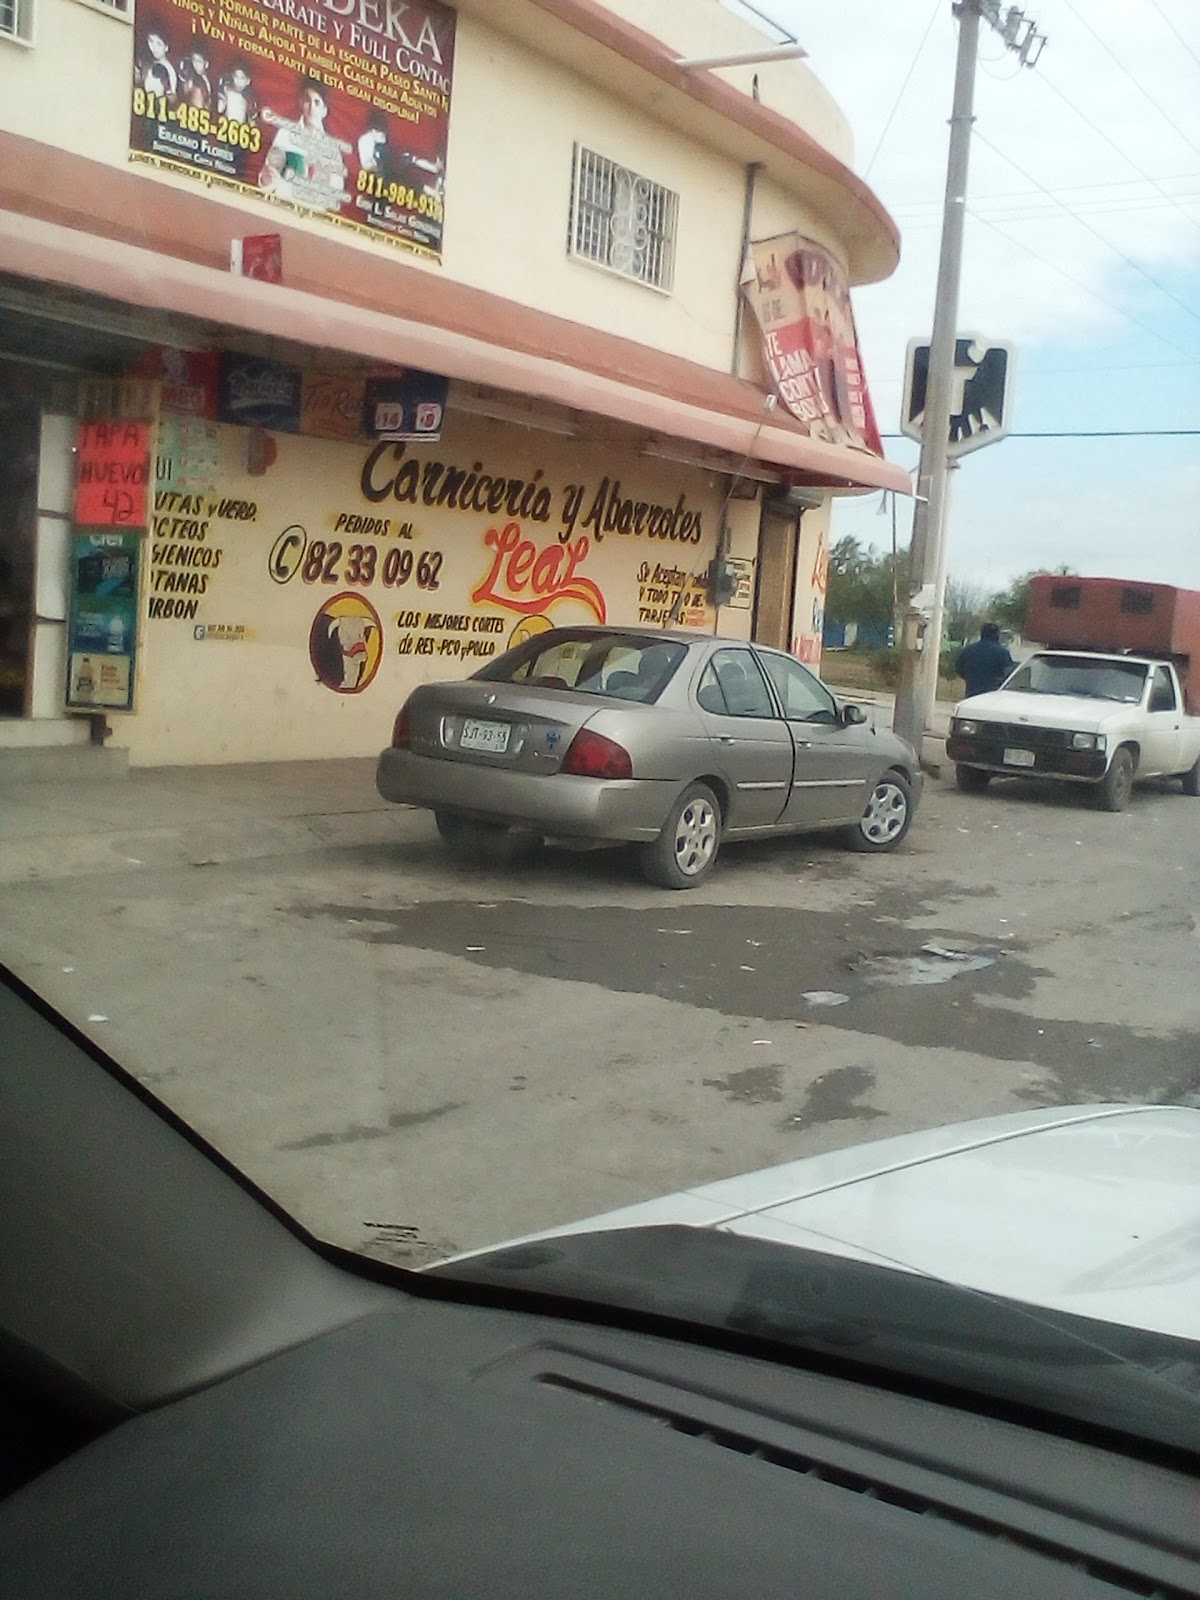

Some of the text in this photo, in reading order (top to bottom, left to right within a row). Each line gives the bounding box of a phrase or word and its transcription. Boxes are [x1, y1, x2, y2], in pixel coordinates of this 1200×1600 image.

[272, 17, 305, 42] PARTE
[307, 33, 321, 50] DE
[323, 41, 336, 56] LA
[339, 49, 377, 75] ESCUELA
[380, 63, 411, 90] PASEO
[331, 20, 344, 40] Y
[349, 22, 391, 63] FULL
[238, 37, 276, 62] FORMA
[277, 53, 307, 76] PARTE
[323, 73, 345, 92] ESTA
[258, 26, 296, 53] AHORA
[343, 63, 374, 90] CLASES
[376, 82, 399, 101] PARA
[133, 87, 261, 153] 811-485-2663
[334, 512, 413, 540] PEDIDOS AL
[582, 476, 703, 545] Abarrotes
[151, 569, 209, 595] TANAS
[647, 588, 669, 605] TODO
[397, 611, 505, 634] LOS MEJORES CORTES
[414, 637, 435, 655] RES
